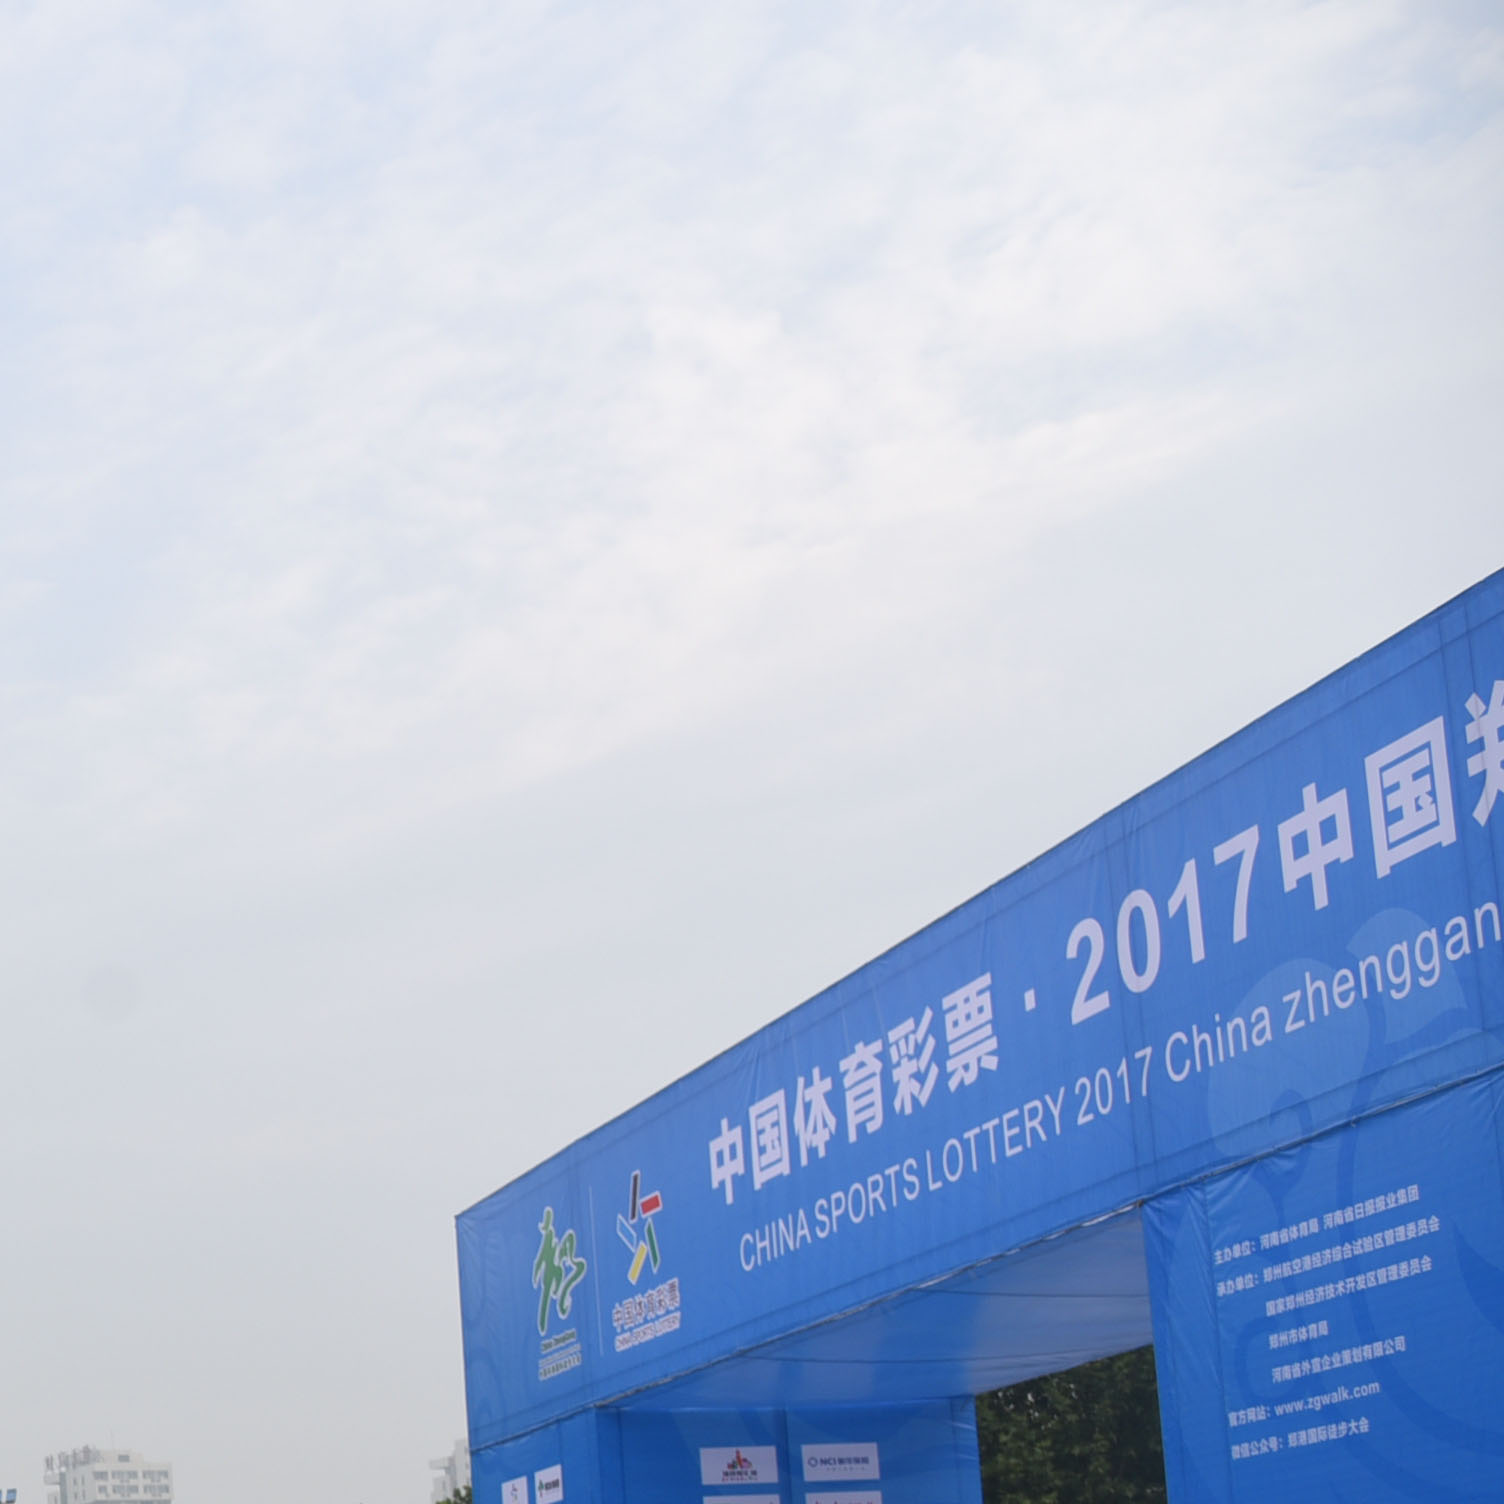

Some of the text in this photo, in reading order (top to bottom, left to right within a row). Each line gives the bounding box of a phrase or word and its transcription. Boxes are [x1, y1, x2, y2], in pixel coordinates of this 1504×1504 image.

[740, 1209, 811, 1271] CHINA
[816, 1158, 920, 1238] SPORTS
[926, 1087, 1065, 1192] LOTTERY
[1077, 1046, 1152, 1125] 2017
[1165, 1006, 1273, 1082] China
